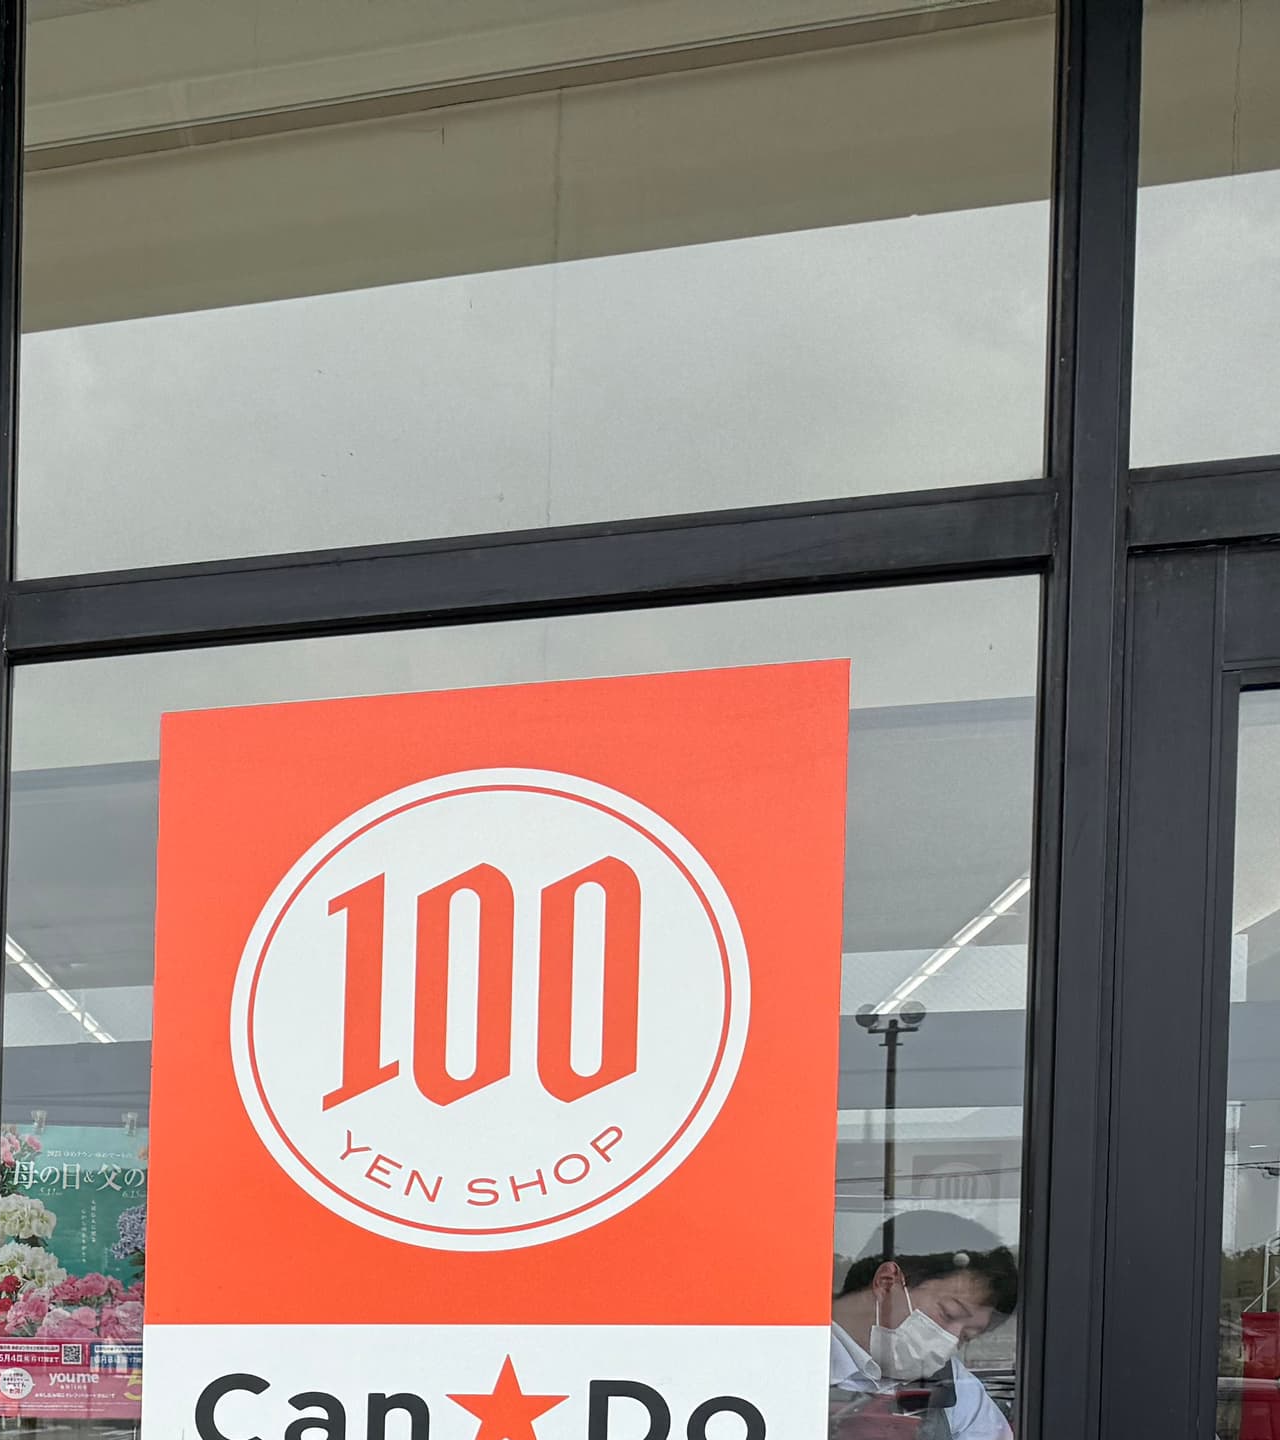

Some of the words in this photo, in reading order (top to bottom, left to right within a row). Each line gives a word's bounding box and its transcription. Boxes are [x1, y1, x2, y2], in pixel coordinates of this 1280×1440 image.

[321, 856, 642, 1113] 100
[339, 1129, 444, 1206] YEN
[465, 1125, 625, 1207] SHOP
[49, 1372, 100, 1386] youme
